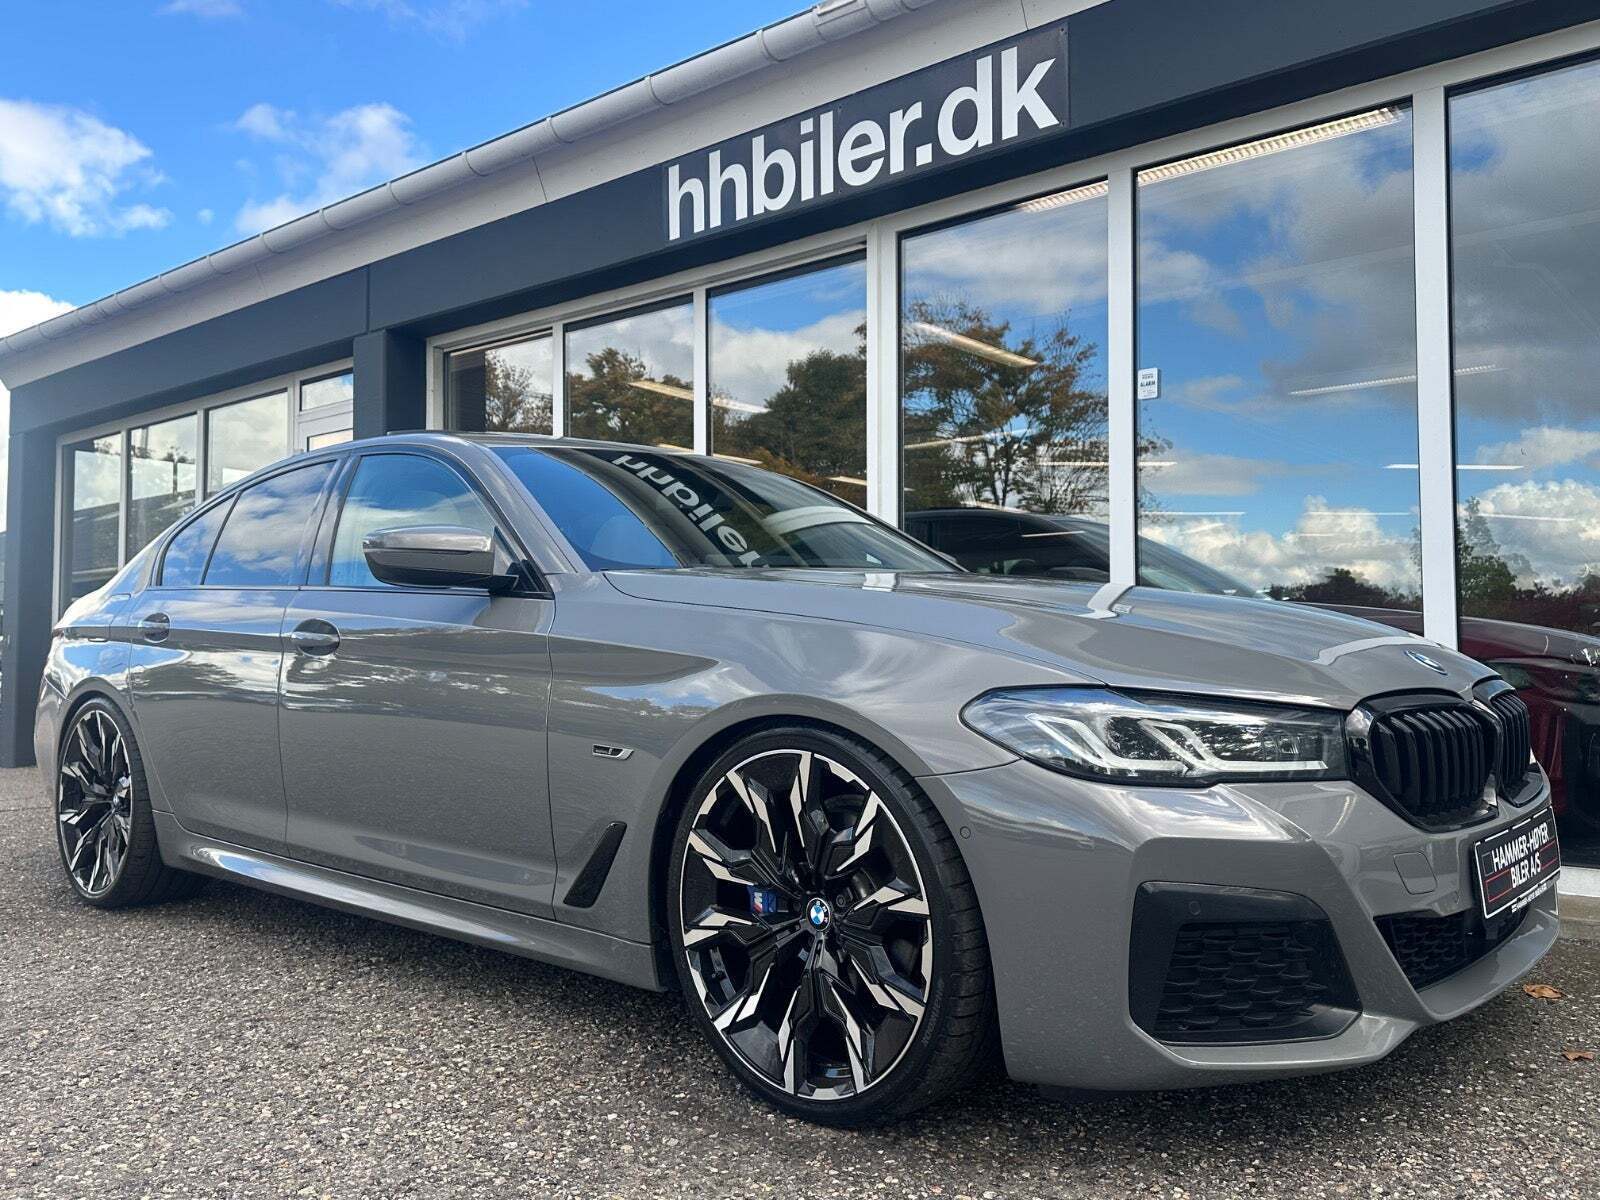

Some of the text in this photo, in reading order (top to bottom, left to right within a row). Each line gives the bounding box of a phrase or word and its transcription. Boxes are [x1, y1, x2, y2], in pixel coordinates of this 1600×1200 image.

[668, 46, 1060, 240] hhbiler.dk
[1491, 822, 1549, 872] HAMMER-HØYER
[1510, 852, 1541, 889] BILER A/S
